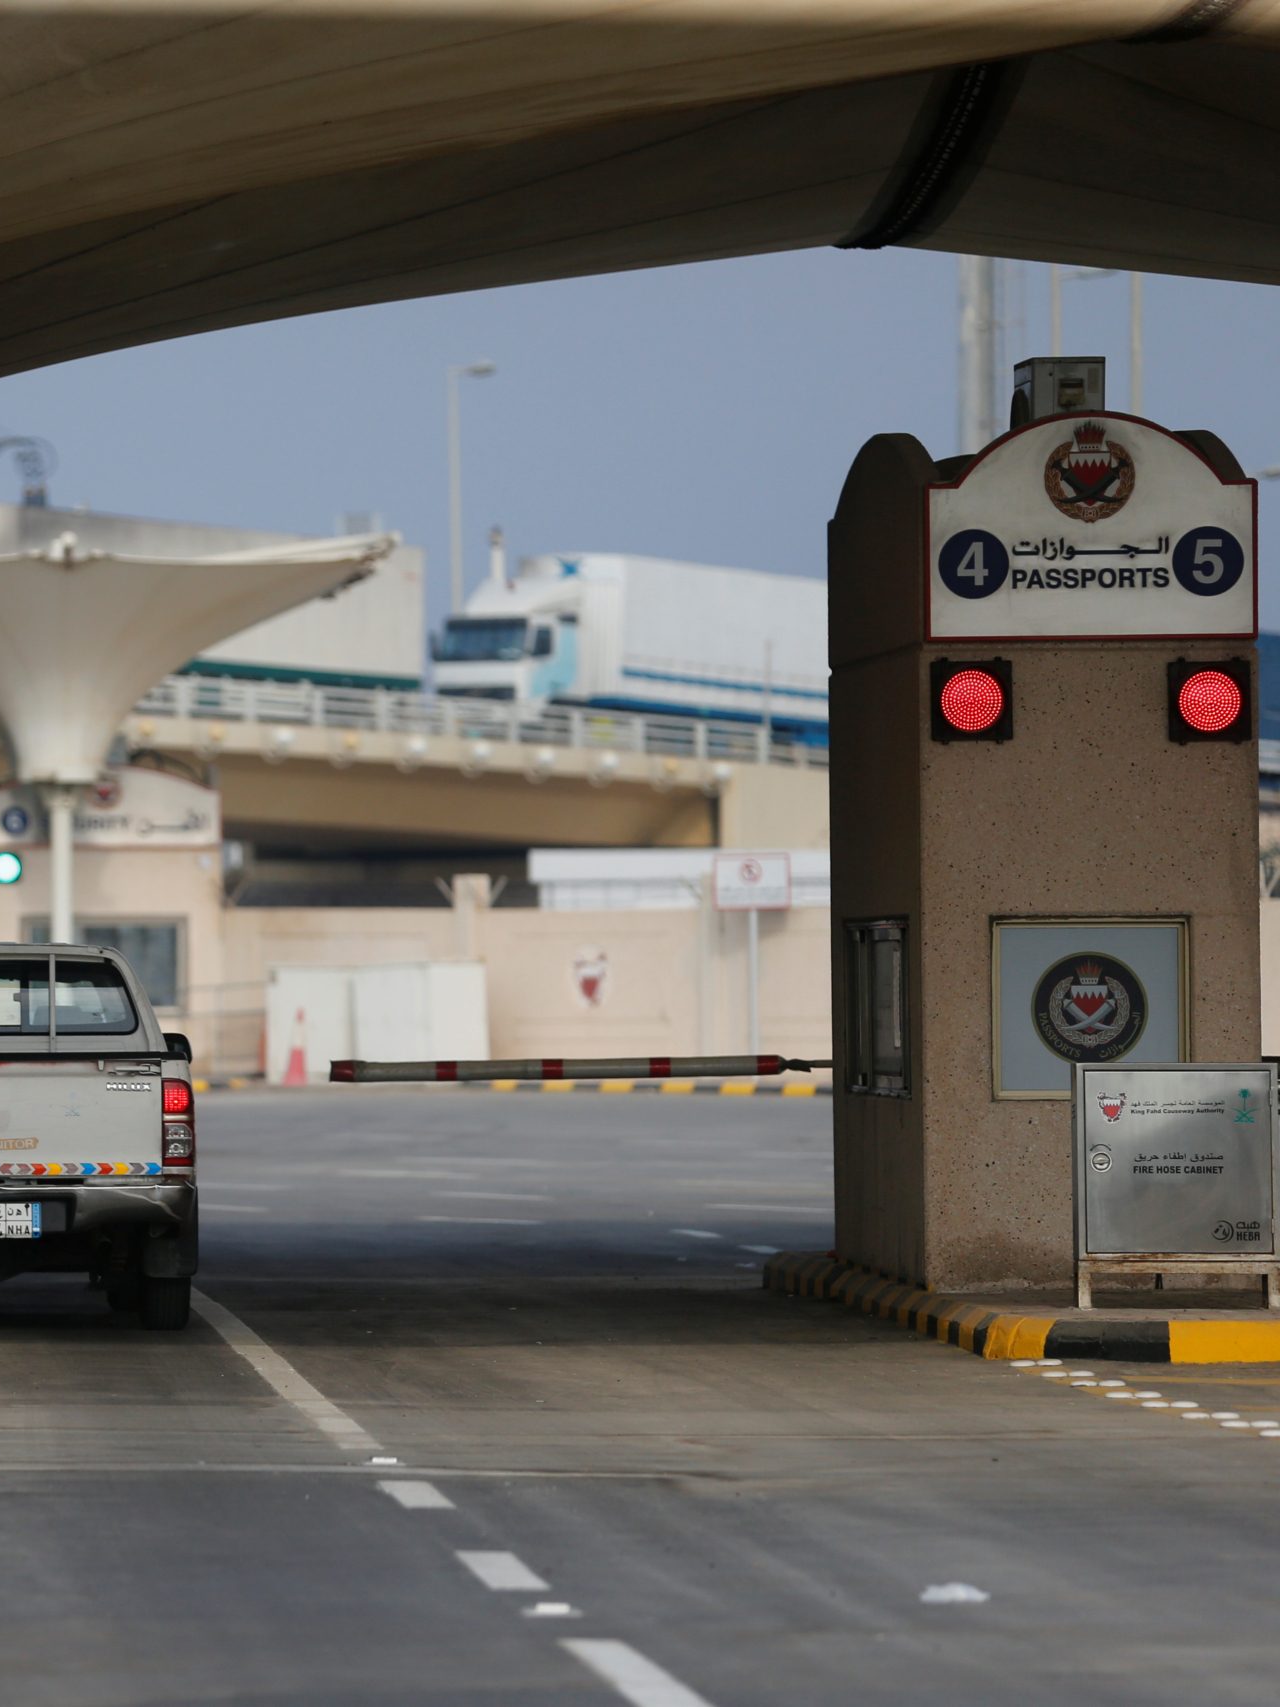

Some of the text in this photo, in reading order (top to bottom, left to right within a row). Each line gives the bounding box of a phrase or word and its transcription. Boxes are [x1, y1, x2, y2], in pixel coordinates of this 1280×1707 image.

[956, 541, 989, 586] 4
[1192, 538, 1224, 584] 5
[1011, 567, 1170, 590] PASSPORTS
[1039, 1012, 1081, 1058] PASSPORTS
[1133, 1165, 1224, 1174] FIRE HOSE CABINET
[7, 1224, 30, 1235] NHA
[1236, 1231, 1261, 1241] HEBA
